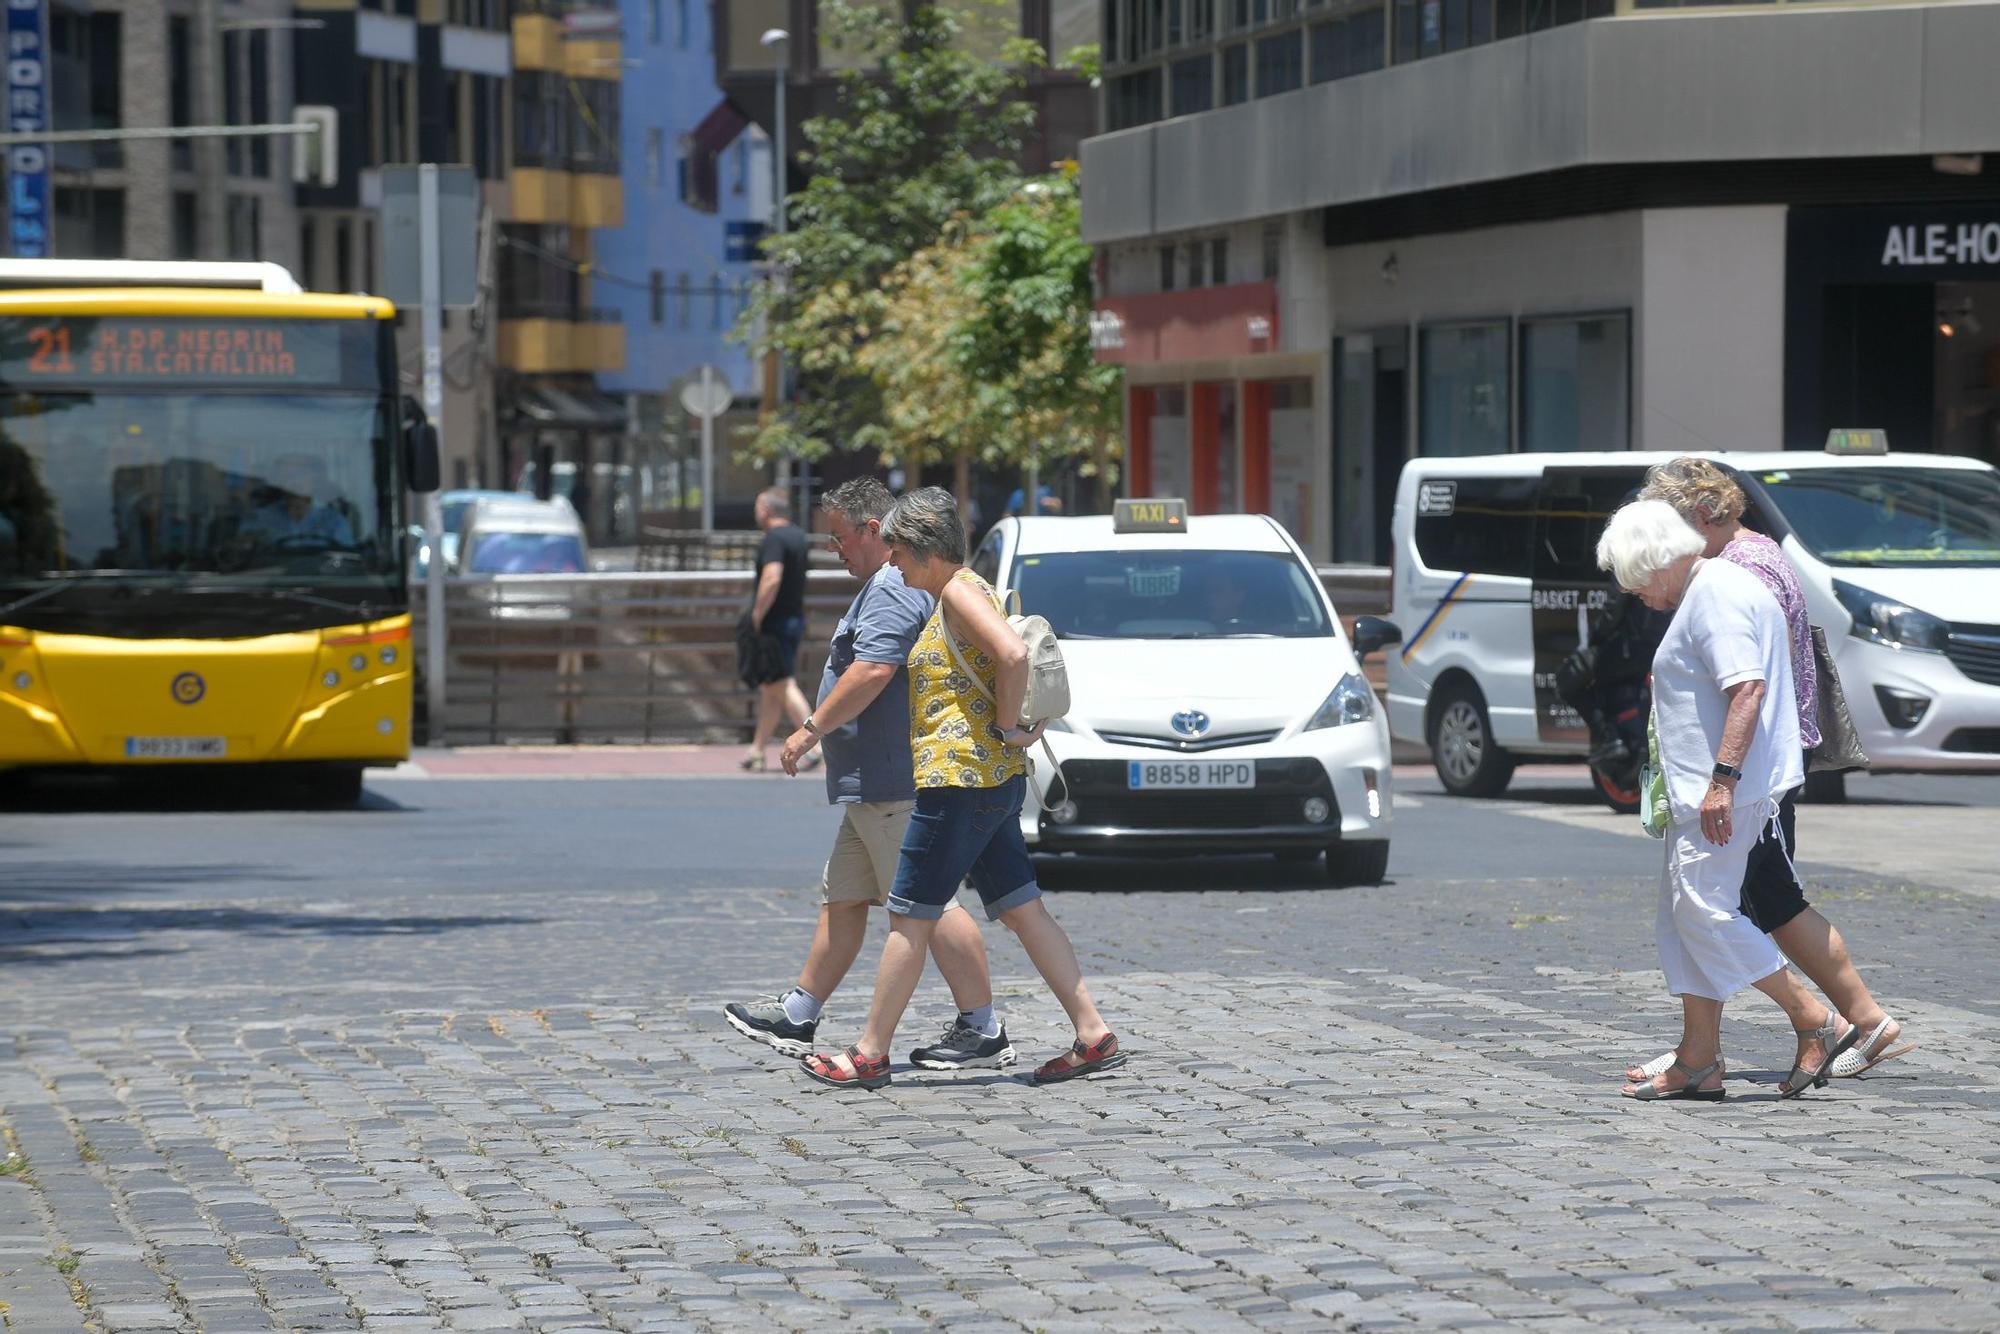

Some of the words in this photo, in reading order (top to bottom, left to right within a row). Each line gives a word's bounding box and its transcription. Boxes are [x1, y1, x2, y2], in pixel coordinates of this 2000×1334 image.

[27, 327, 75, 374] 21
[90, 351, 296, 375] STA.CATALINA
[1129, 503, 1165, 523] TAXI
[1132, 573, 1177, 594] LIBRE
[1532, 590, 1579, 609] BASKET
[1145, 764, 1201, 784] 8858
[1208, 764, 1250, 784] HPD
